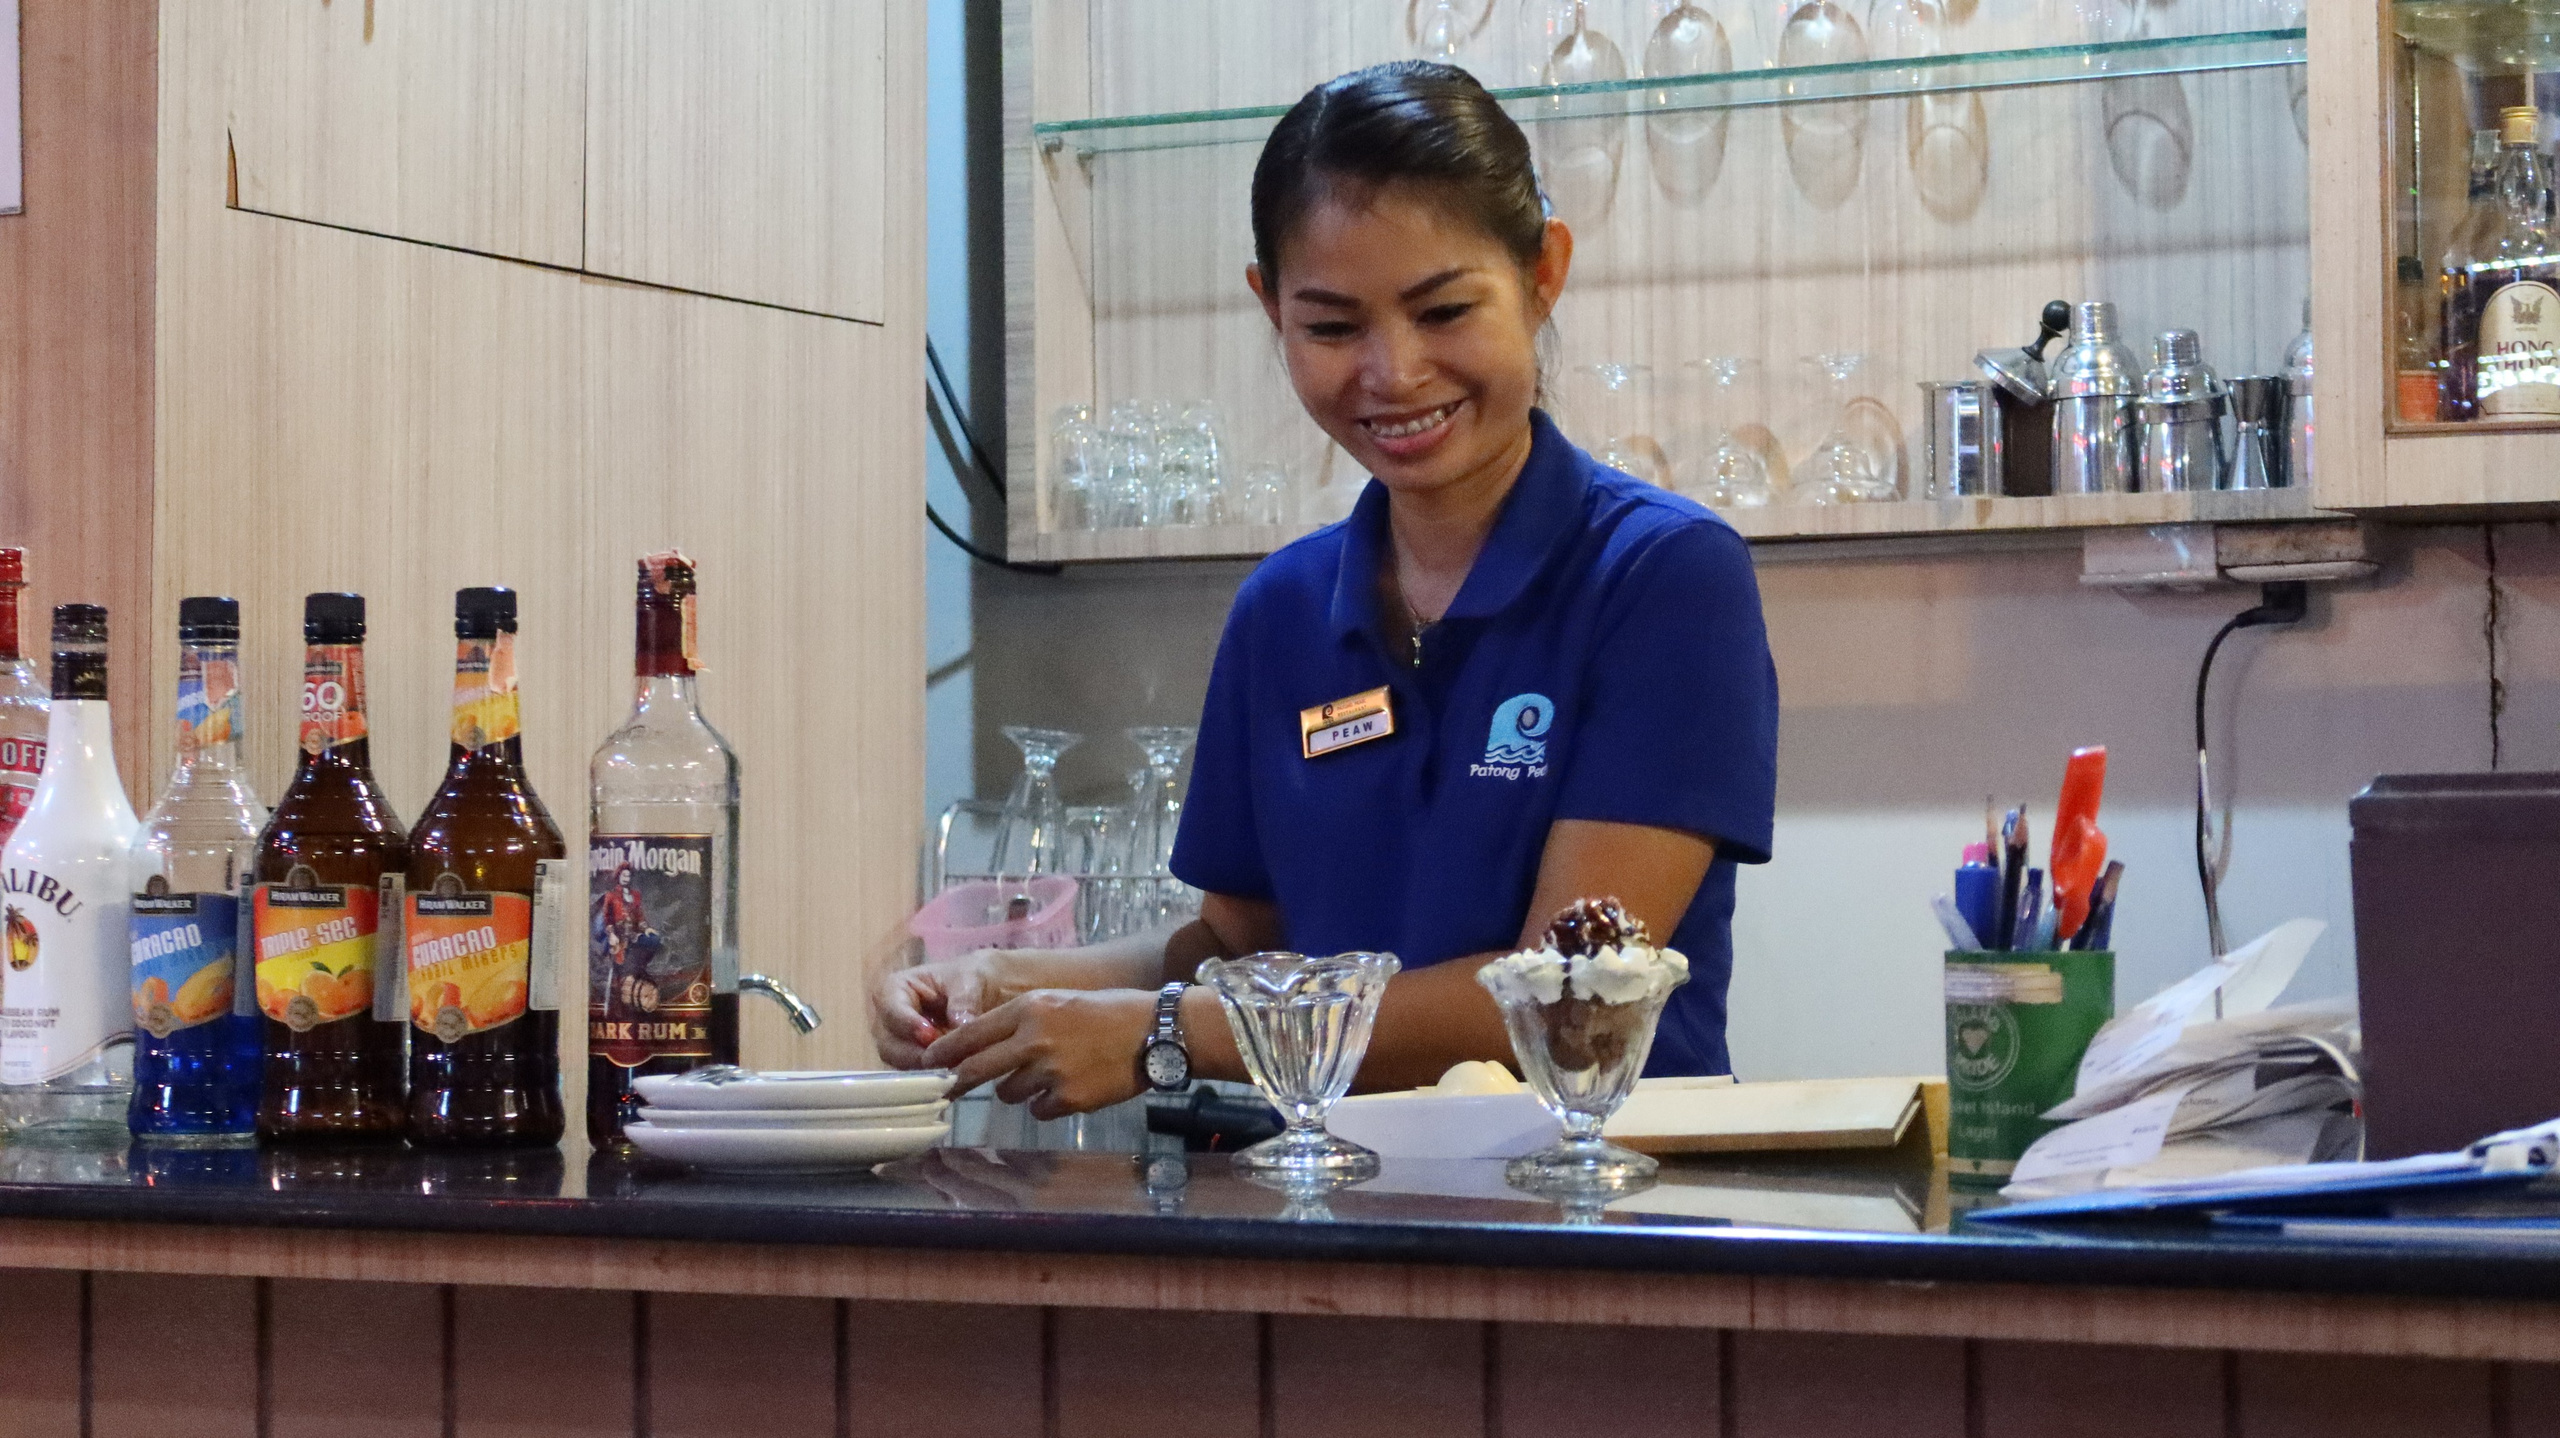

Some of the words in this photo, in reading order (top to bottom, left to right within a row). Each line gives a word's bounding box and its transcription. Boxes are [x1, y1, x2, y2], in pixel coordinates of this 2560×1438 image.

[302, 681, 346, 712] 60
[301, 712, 343, 722] ROOF
[1332, 721, 1373, 741] PEAW
[1469, 764, 1521, 780] Patong
[625, 840, 702, 877] Morgan
[638, 1022, 687, 1040] RUM
